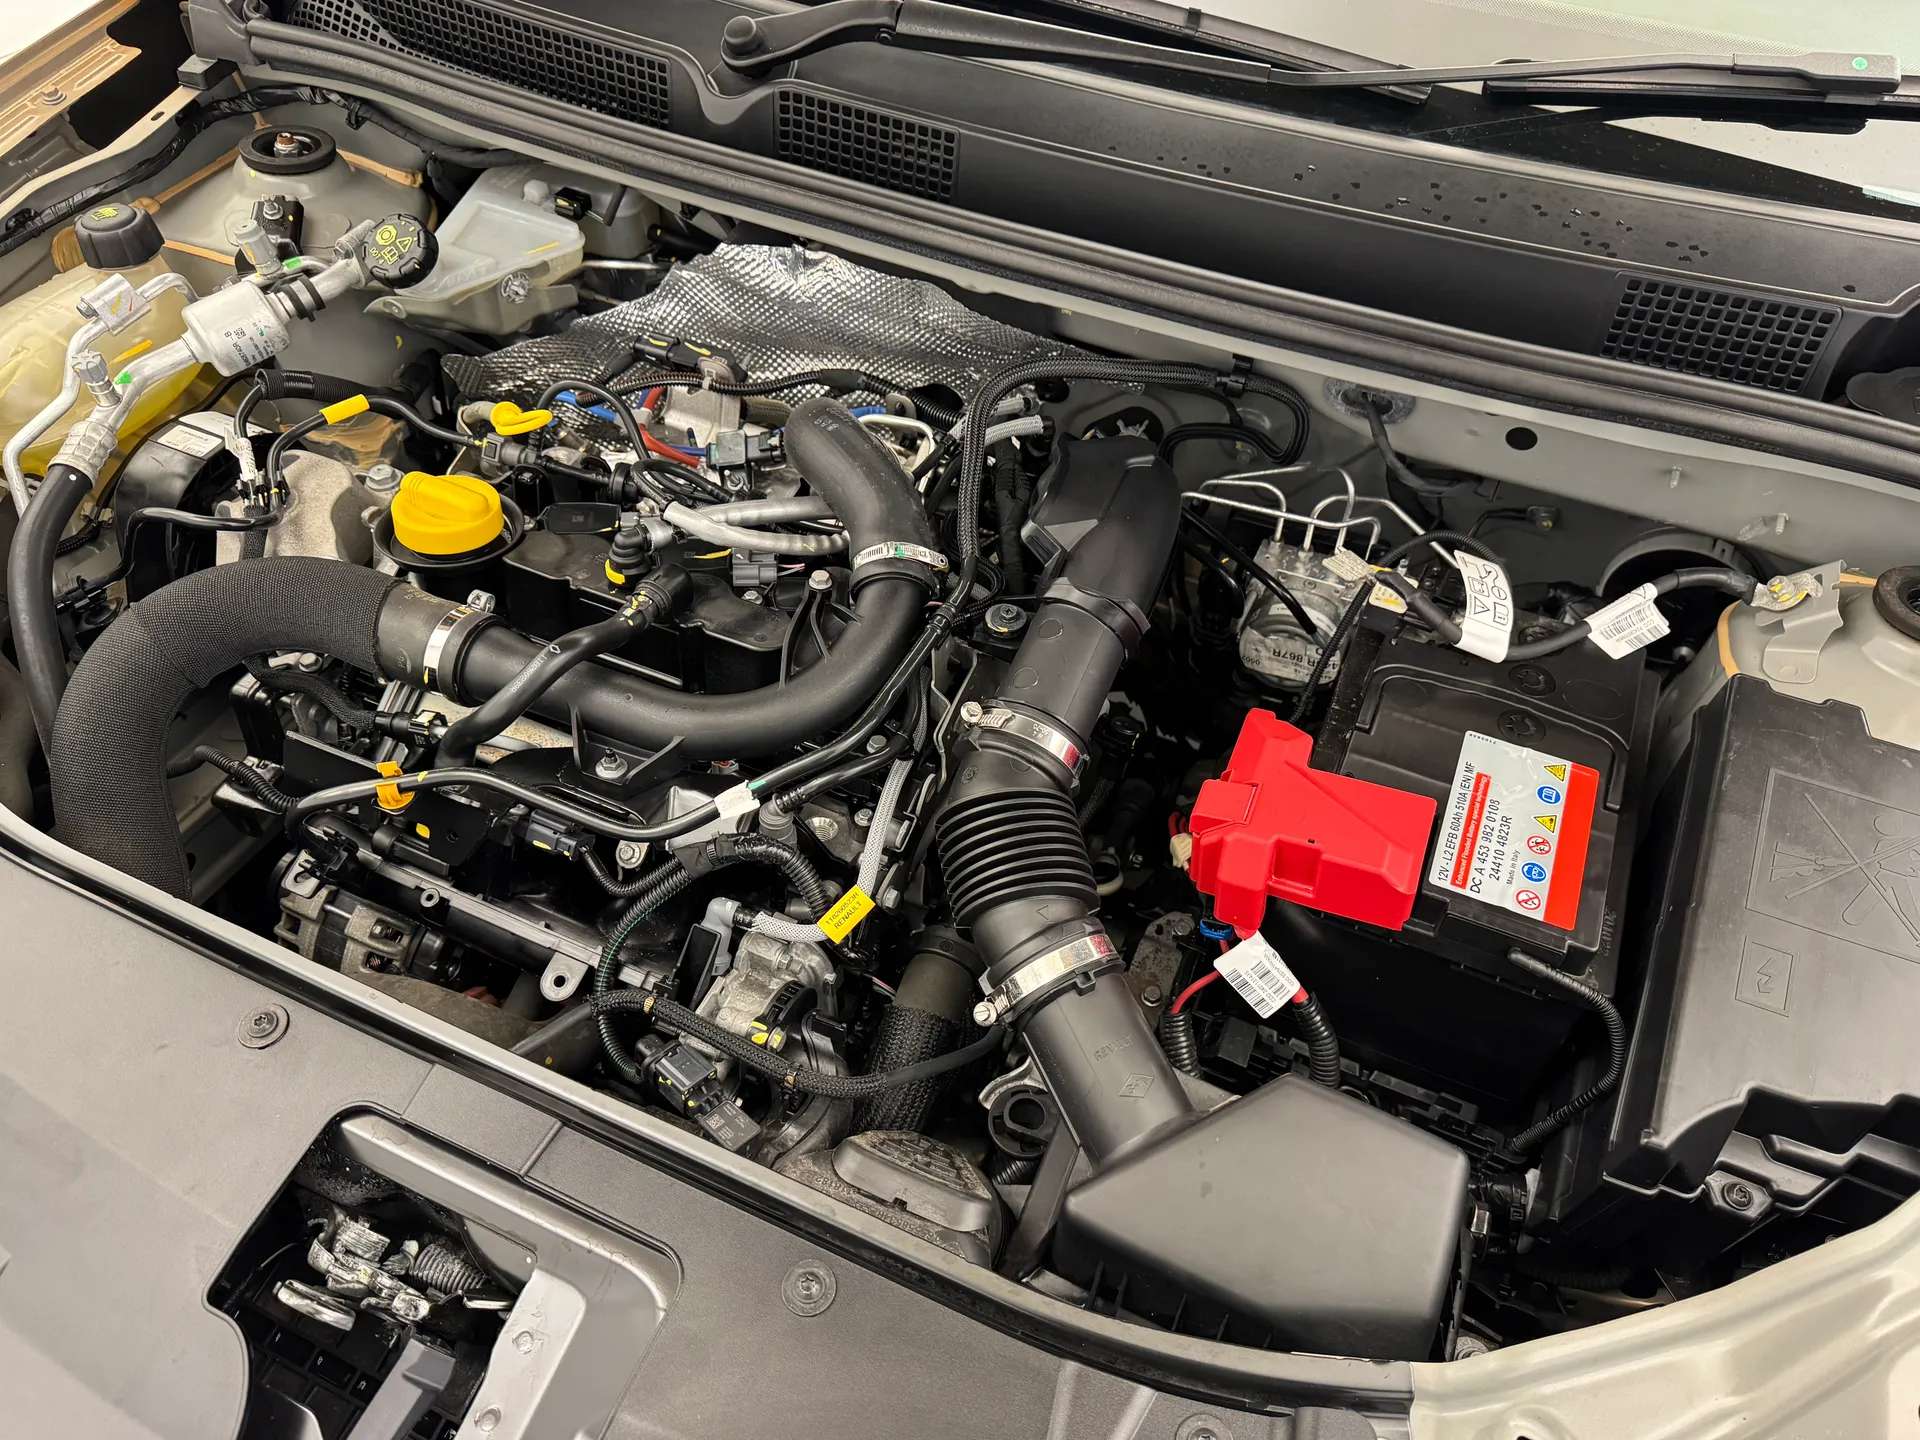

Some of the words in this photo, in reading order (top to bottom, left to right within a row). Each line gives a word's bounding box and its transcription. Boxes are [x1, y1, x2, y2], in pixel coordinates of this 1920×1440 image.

[1272, 649, 1303, 663] 867R
[1464, 761, 1475, 775] MF
[1459, 773, 1473, 792] (EN)
[1455, 790, 1468, 811] 510A
[1485, 798, 1500, 823] 0108
[1449, 810, 1463, 832] 60Ah
[1496, 815, 1513, 848] 4823R
[1445, 831, 1458, 850] EFB
[1481, 824, 1494, 844] 982
[1442, 848, 1454, 861] L2
[1460, 837, 1472, 859] Flooded
[1476, 844, 1490, 865] 453
[1438, 865, 1450, 882] 12V
[1455, 858, 1467, 885] Enhanced
[1474, 865, 1485, 876] A
[1488, 848, 1506, 881] 24410
[1506, 868, 1516, 886] Made
[1511, 849, 1521, 862] Italy
[1470, 877, 1482, 894] DC
[833, 900, 862, 930] RENAULT
